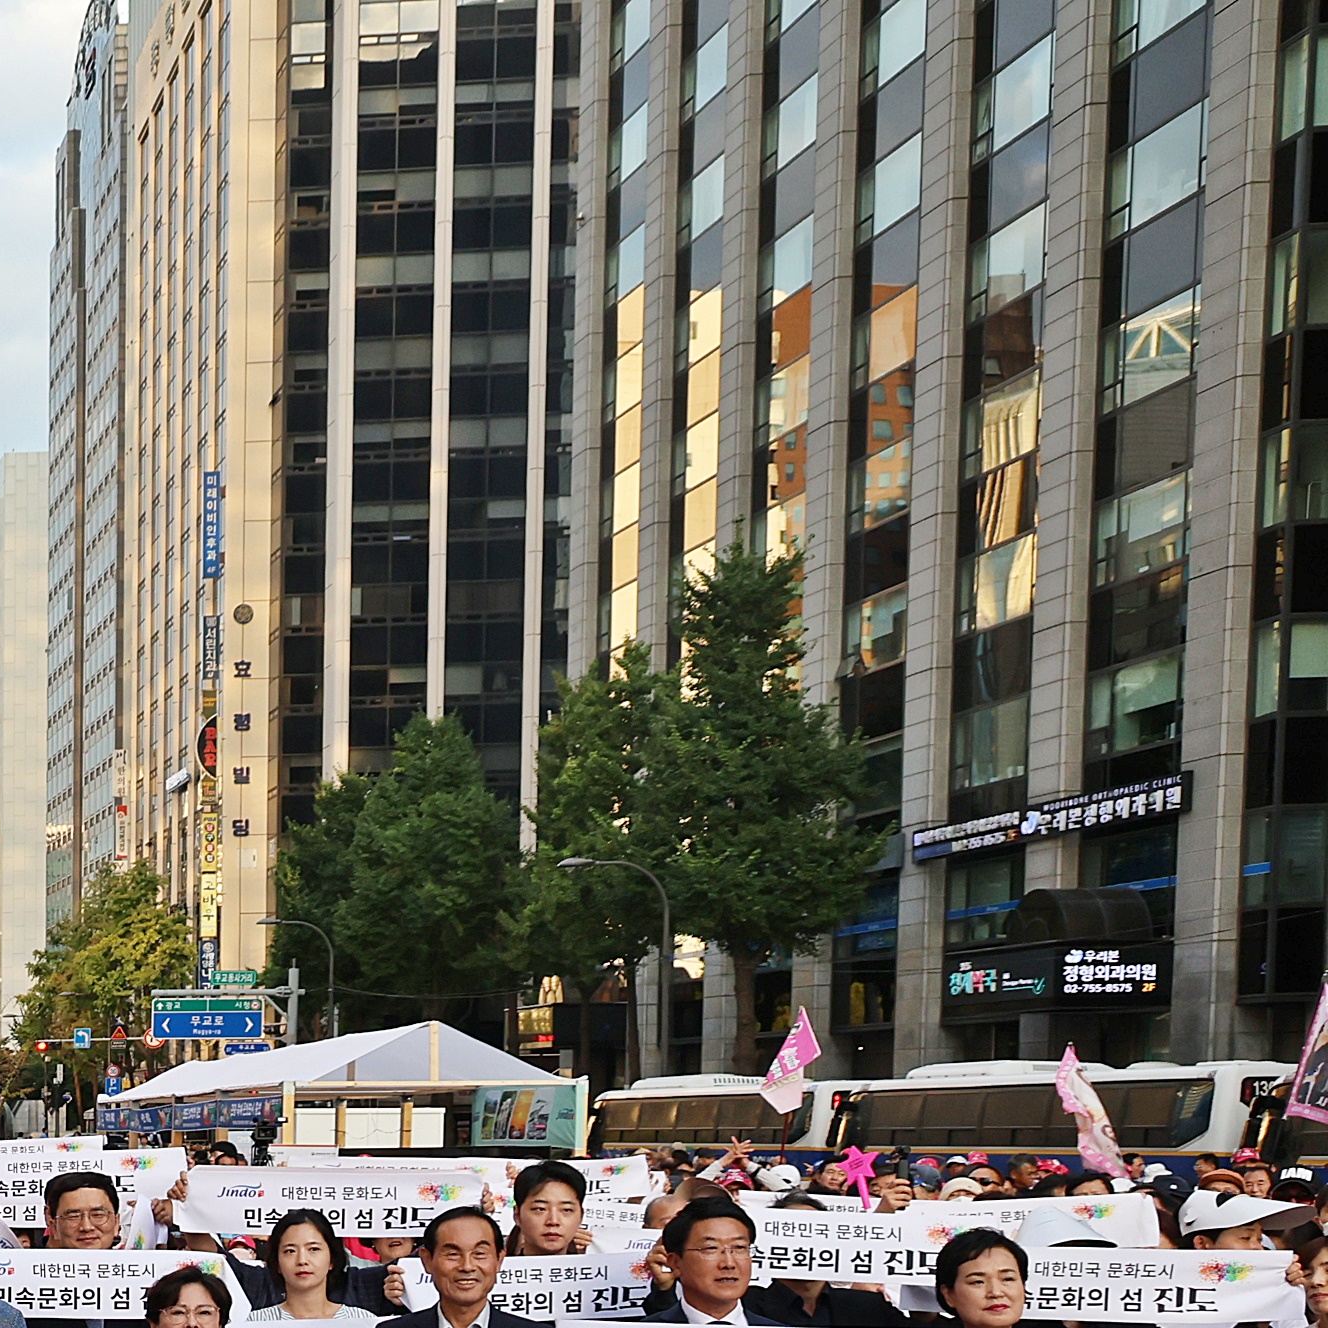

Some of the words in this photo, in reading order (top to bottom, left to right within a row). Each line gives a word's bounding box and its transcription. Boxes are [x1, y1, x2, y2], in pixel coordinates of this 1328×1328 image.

[206, 476, 217, 561] 미래이비인후과
[204, 727, 217, 767] BAR
[1063, 964, 1157, 982] 정형외과의원
[1064, 983, 1132, 993] 02-755-8575
[1142, 983, 1156, 992] 2F
[190, 1016, 225, 1026] 무교로
[7, 1161, 52, 1173] 대한민국
[57, 1160, 103, 1172] 문화도시
[282, 1186, 336, 1201] 대한민국
[341, 1186, 398, 1201] 문화도시
[764, 1221, 830, 1239] 대한민국
[836, 1223, 902, 1242] 문화도시
[33, 1262, 91, 1278] 대한민국
[96, 1261, 155, 1278] 문화도시
[850, 1251, 873, 1274] 섬
[1035, 1262, 1101, 1278] 대한민국
[1107, 1262, 1175, 1280] 문화도시
[549, 1266, 608, 1283] 문화도시
[562, 1290, 582, 1314] 섬
[1120, 1288, 1143, 1312] 섬
[1152, 1285, 1219, 1314] 진도
